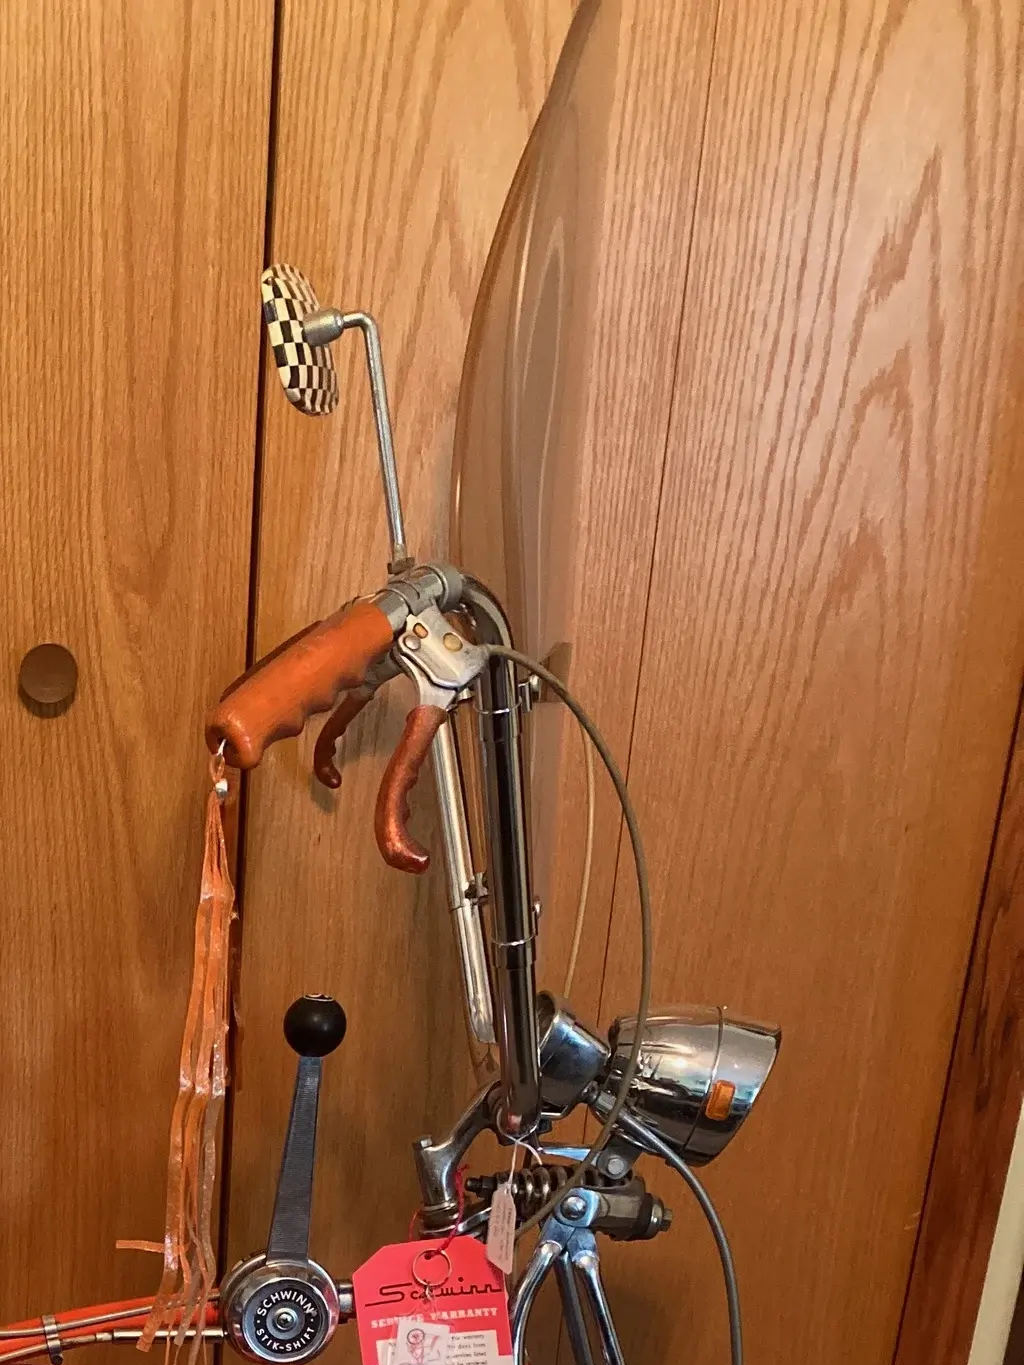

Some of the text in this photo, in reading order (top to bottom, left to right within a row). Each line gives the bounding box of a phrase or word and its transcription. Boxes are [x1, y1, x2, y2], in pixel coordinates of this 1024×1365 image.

[257, 1290, 315, 1317] SCHWINN
[430, 1308, 498, 1321] WARRANTY
[256, 1326, 315, 1351] STIK-SHIFT
